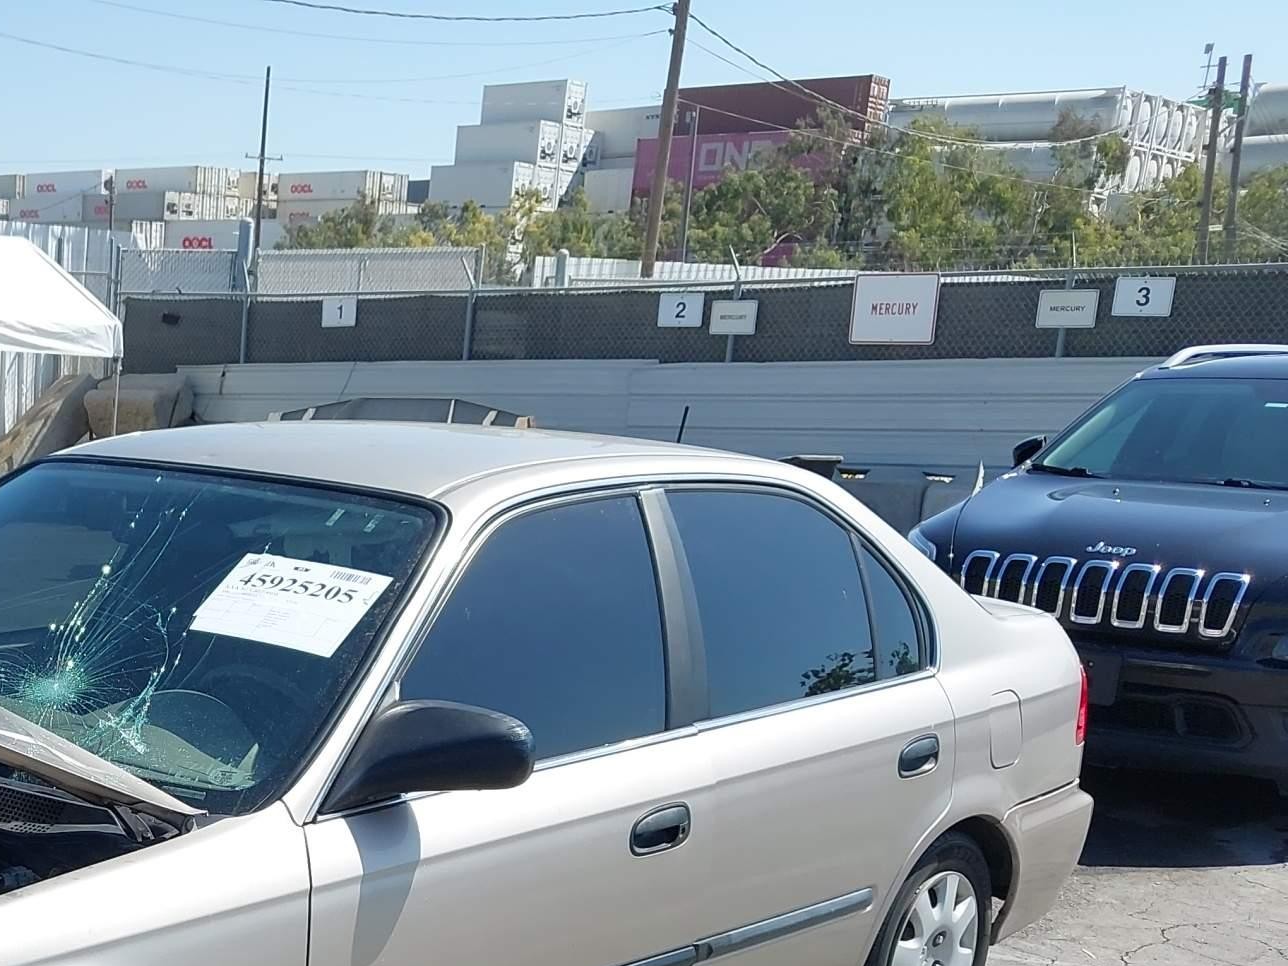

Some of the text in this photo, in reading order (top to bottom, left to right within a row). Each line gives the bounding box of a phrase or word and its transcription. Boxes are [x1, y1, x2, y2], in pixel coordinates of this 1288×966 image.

[36, 183, 57, 193] OOCL
[126, 180, 148, 189] OOCL
[291, 184, 313, 194] OOCL
[182, 237, 214, 249] OOCL
[1135, 287, 1151, 307] 3
[336, 304, 343, 320] 1
[674, 301, 686, 319] 2
[871, 302, 919, 316] MERCURY
[1086, 541, 1137, 557] Jeep
[239, 571, 359, 605] 45925205
